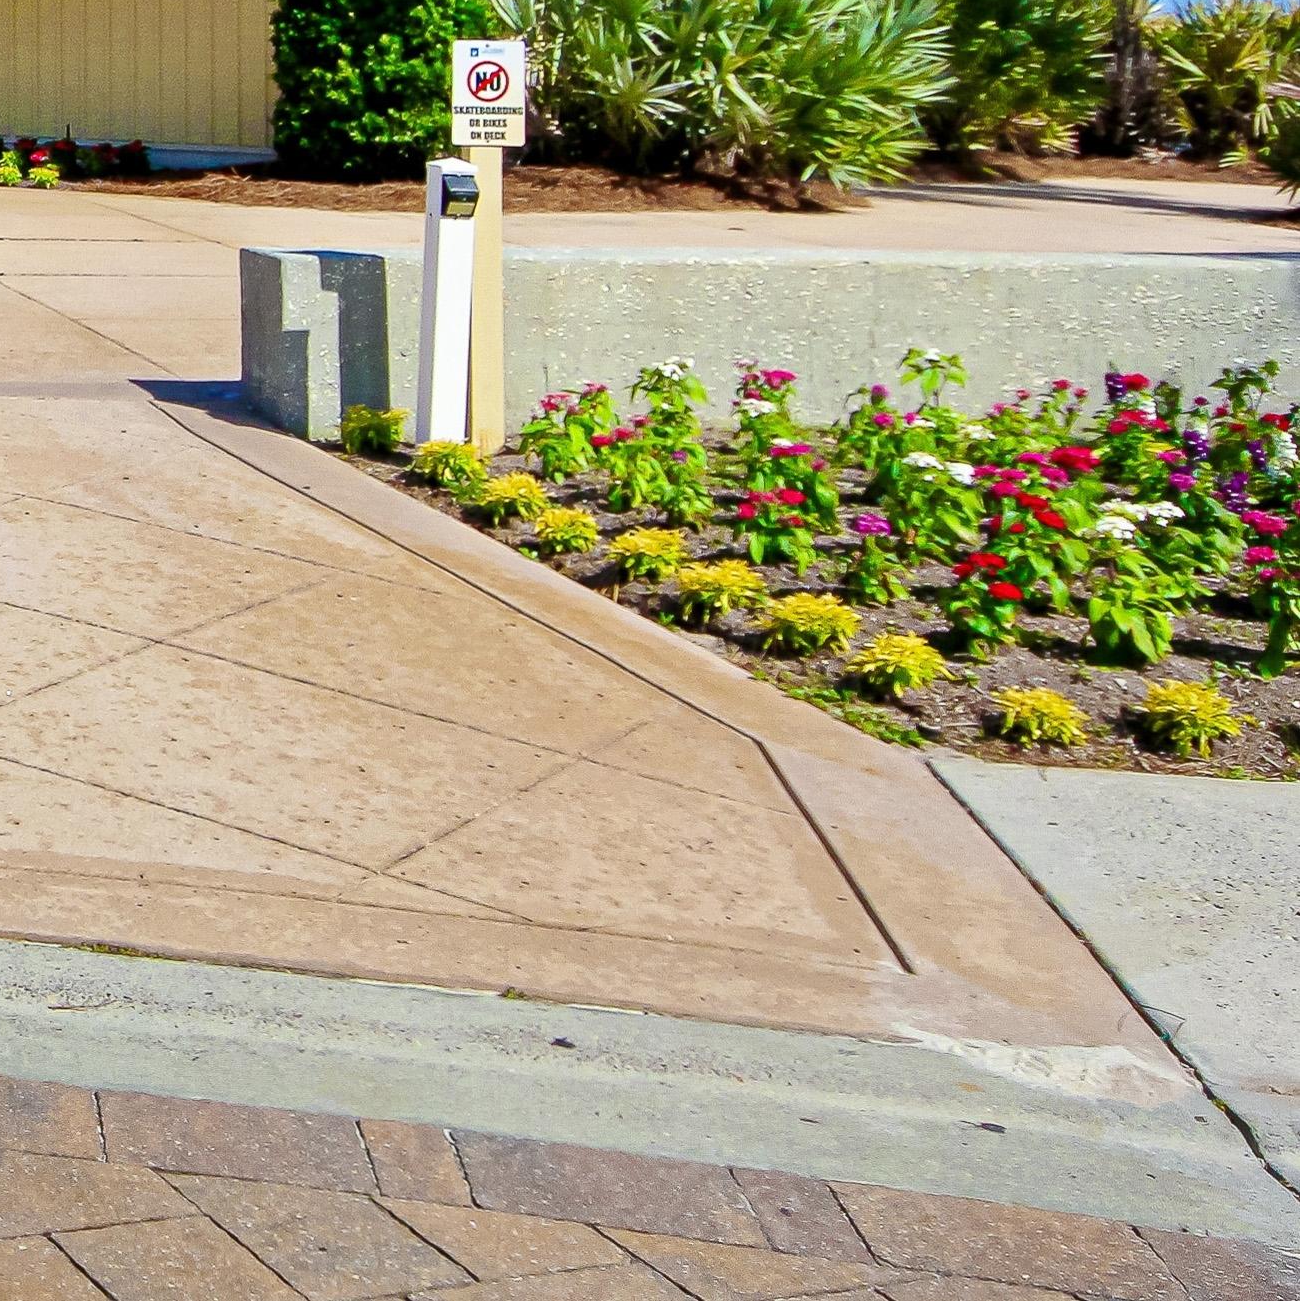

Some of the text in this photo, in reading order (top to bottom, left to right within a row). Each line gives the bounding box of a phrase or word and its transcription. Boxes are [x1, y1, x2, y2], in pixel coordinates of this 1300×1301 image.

[476, 71, 501, 91] NO
[454, 106, 523, 115] SKATEBOARDING
[469, 119, 507, 127] OR BIKES
[471, 131, 506, 140] ON DECK
